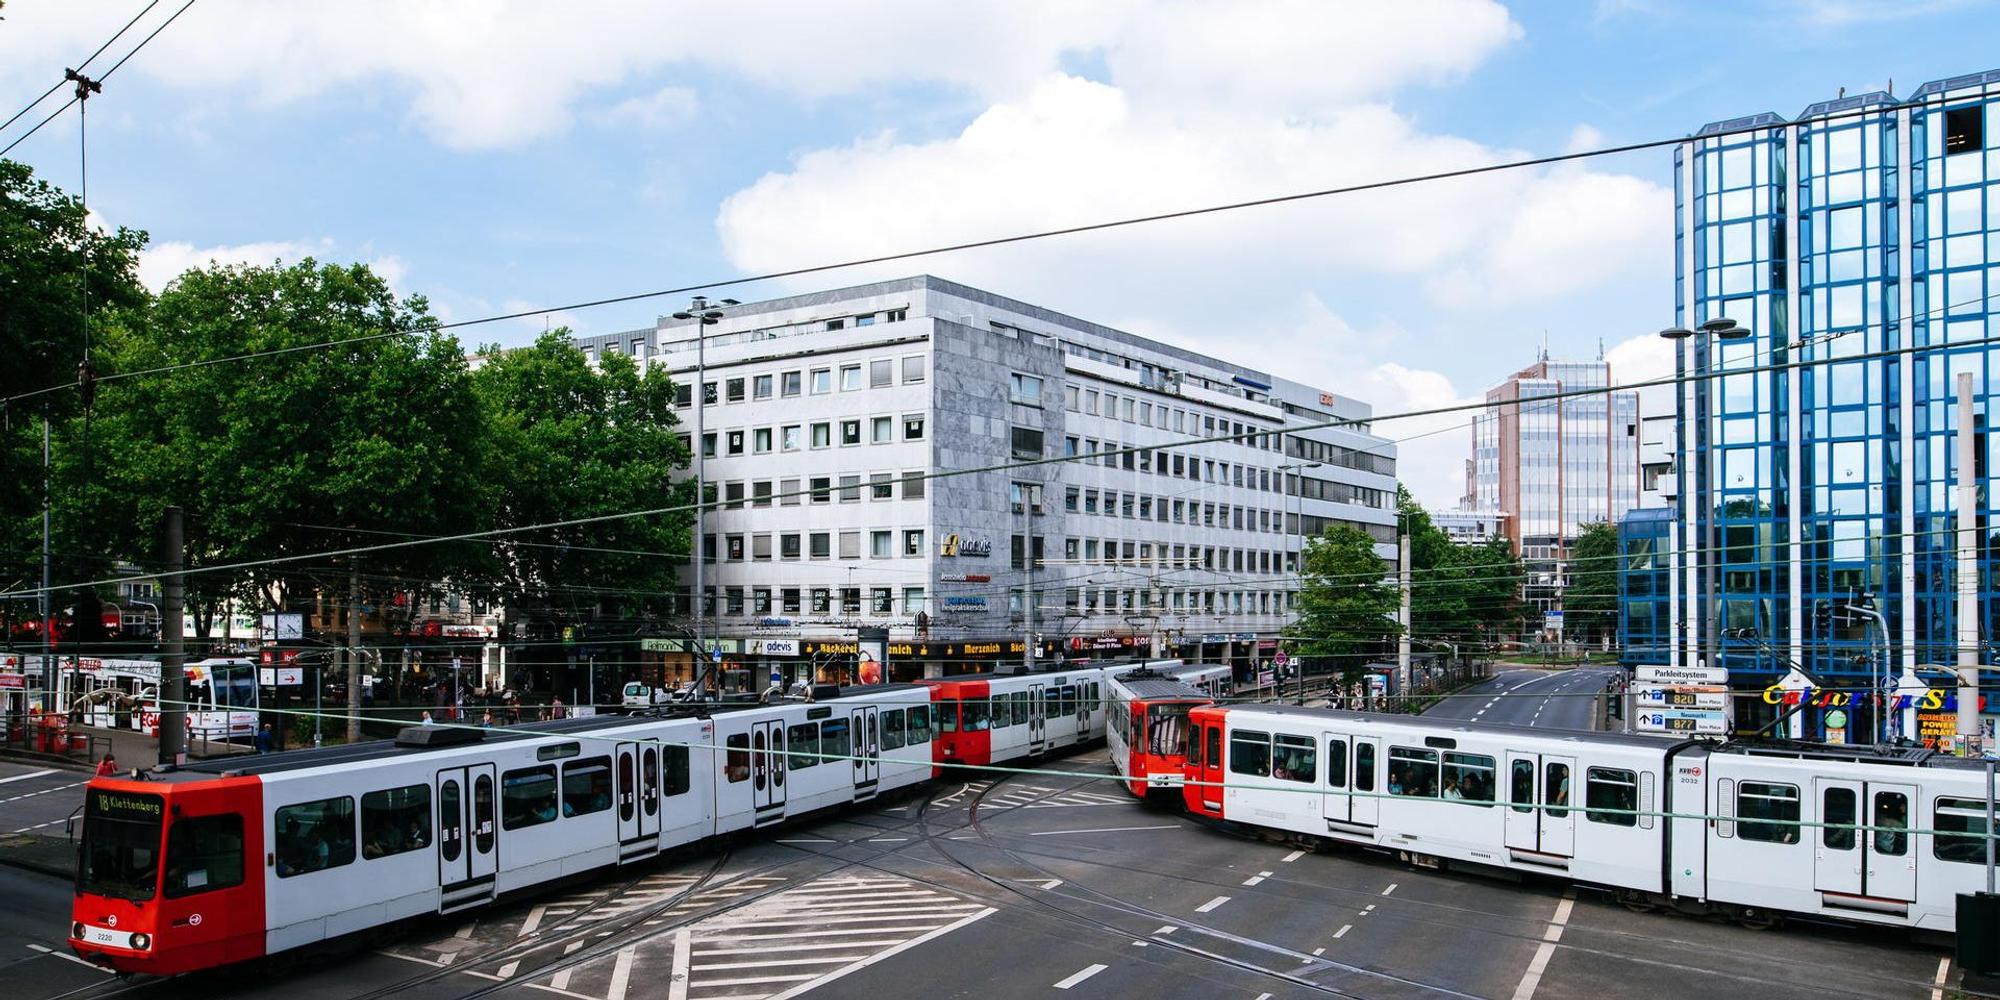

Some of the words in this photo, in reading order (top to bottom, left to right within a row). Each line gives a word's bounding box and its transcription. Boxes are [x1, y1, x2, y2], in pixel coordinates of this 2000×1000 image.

[766, 640, 792, 652] adevis
[964, 644, 1001, 654] Merzenich
[1654, 669, 1708, 679] Parkleitsystem
[1673, 694, 1694, 703] 820
[1673, 719, 1694, 729] 877
[98, 794, 109, 811] 18
[110, 798, 160, 815] Klettenberg
[97, 933, 113, 942] 2220
